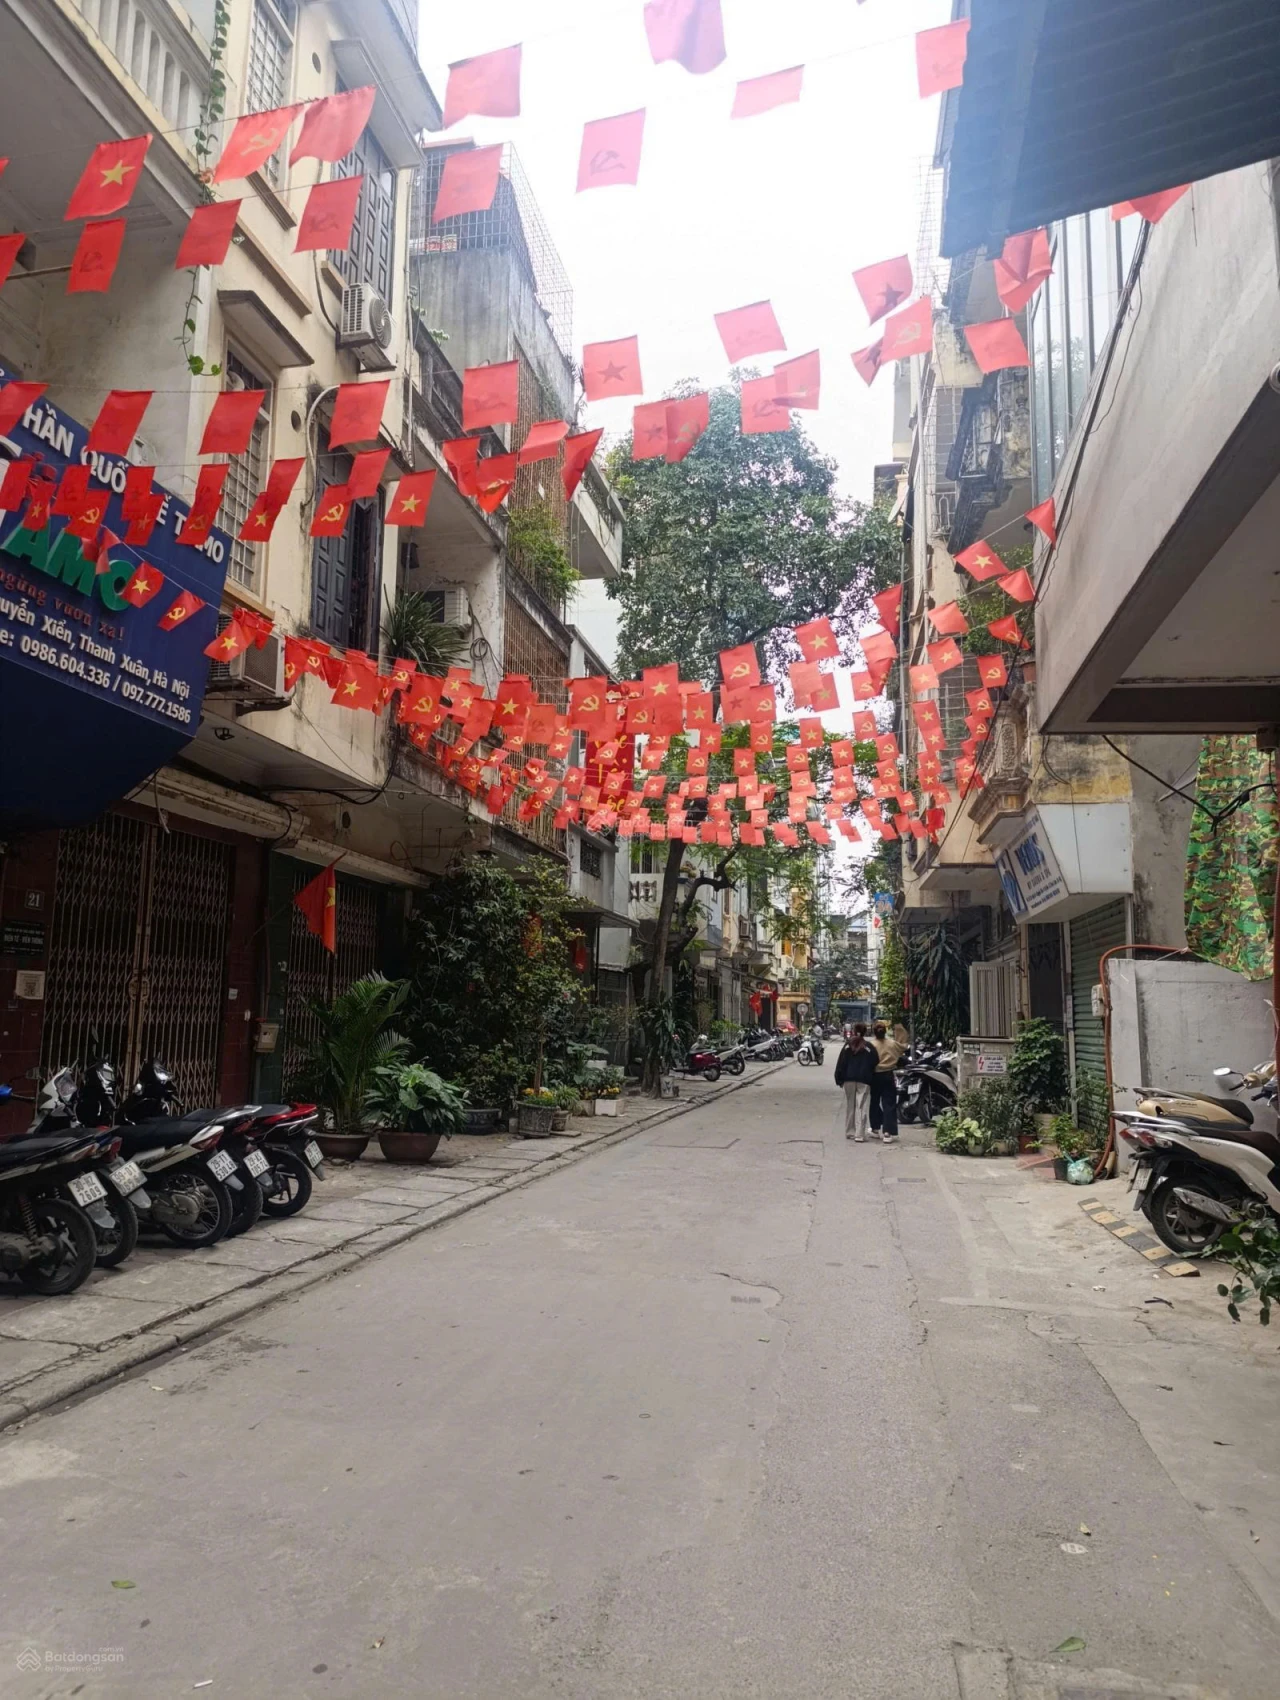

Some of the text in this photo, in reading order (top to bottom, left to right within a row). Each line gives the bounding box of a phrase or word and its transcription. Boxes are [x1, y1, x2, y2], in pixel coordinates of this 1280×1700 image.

[80, 445, 126, 494] QUỐ
[20, 635, 111, 688] 0986.604.336
[122, 681, 192, 724] 097.777.1586
[79, 633, 116, 665] Thanh
[172, 678, 190, 702] Nội
[28, 892, 41, 907] 21
